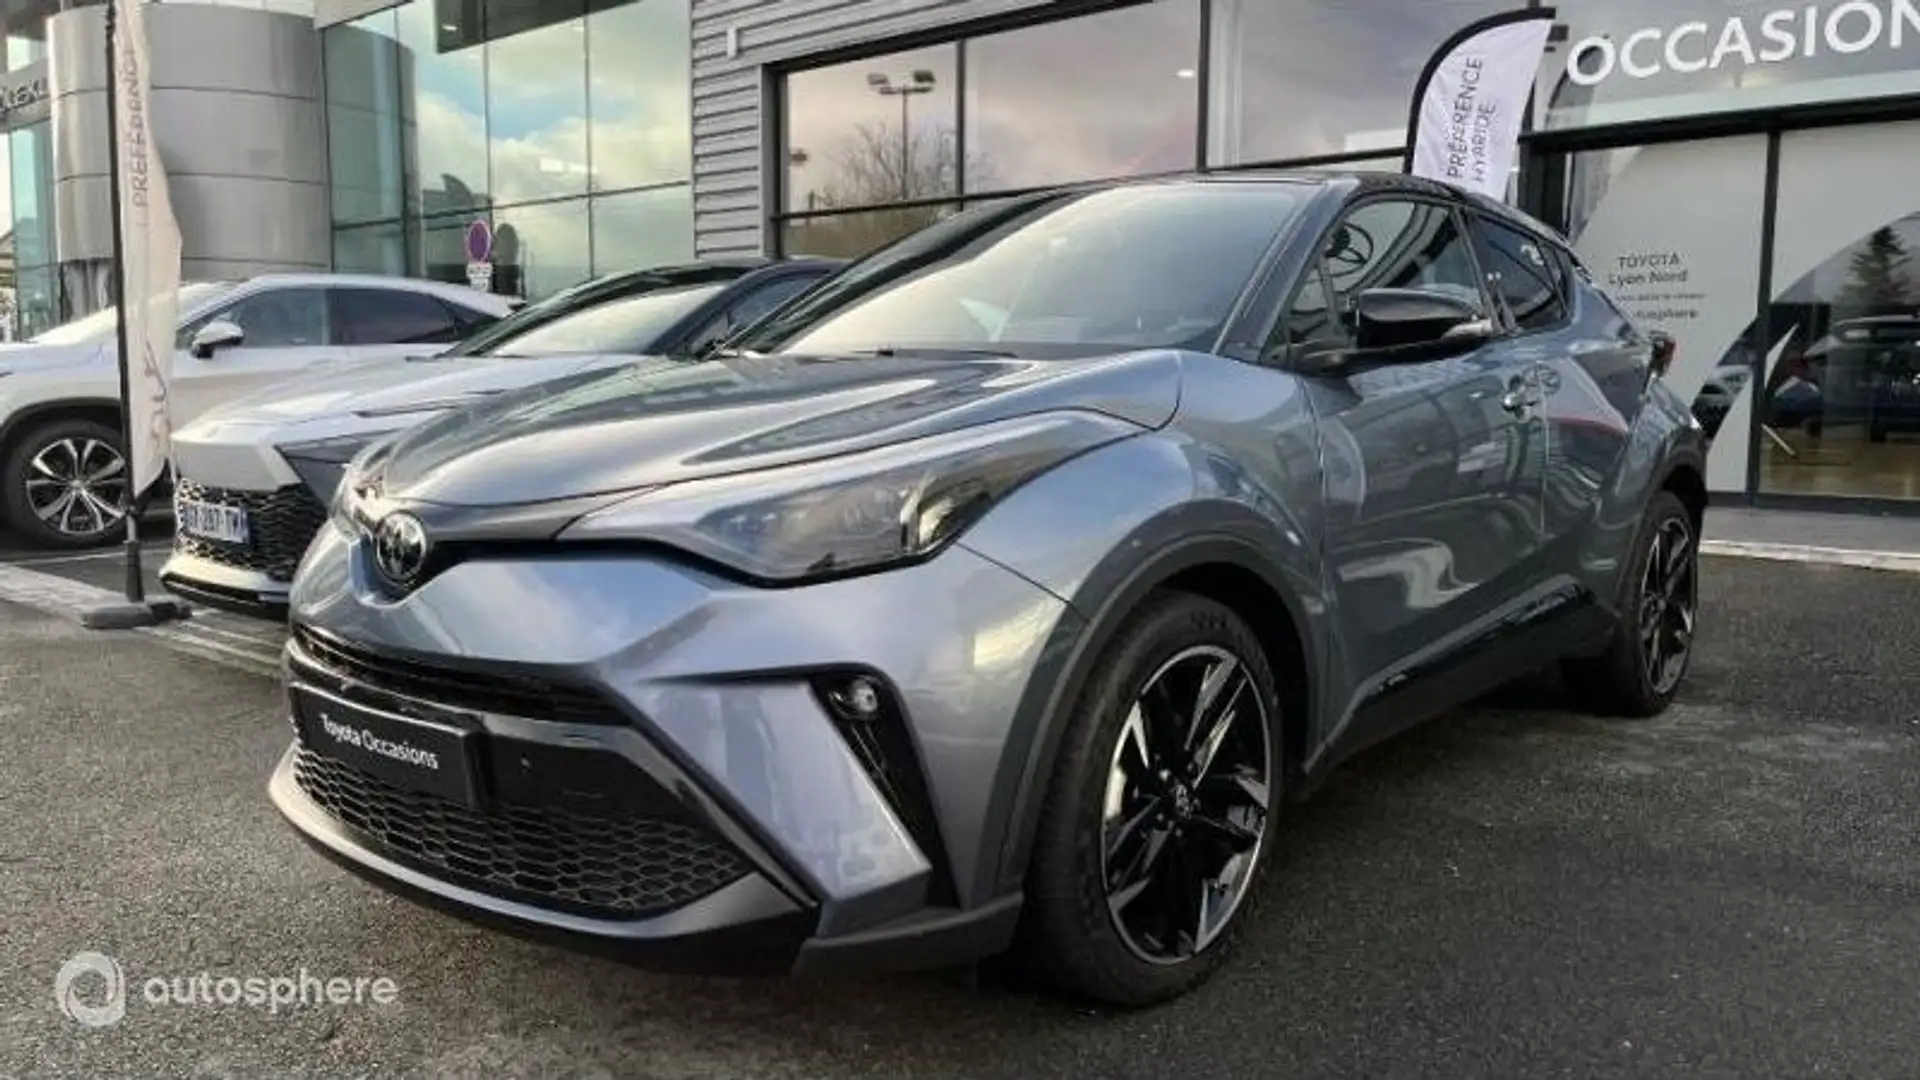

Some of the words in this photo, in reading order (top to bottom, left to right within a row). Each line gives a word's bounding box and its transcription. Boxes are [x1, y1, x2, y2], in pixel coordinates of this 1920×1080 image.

[1616, 252, 1681, 270] TOYOTA
[1608, 273, 1645, 287] Lyon
[1649, 268, 1689, 284] Nord
[320, 712, 361, 748] Toyota
[362, 729, 439, 770] Occasions
